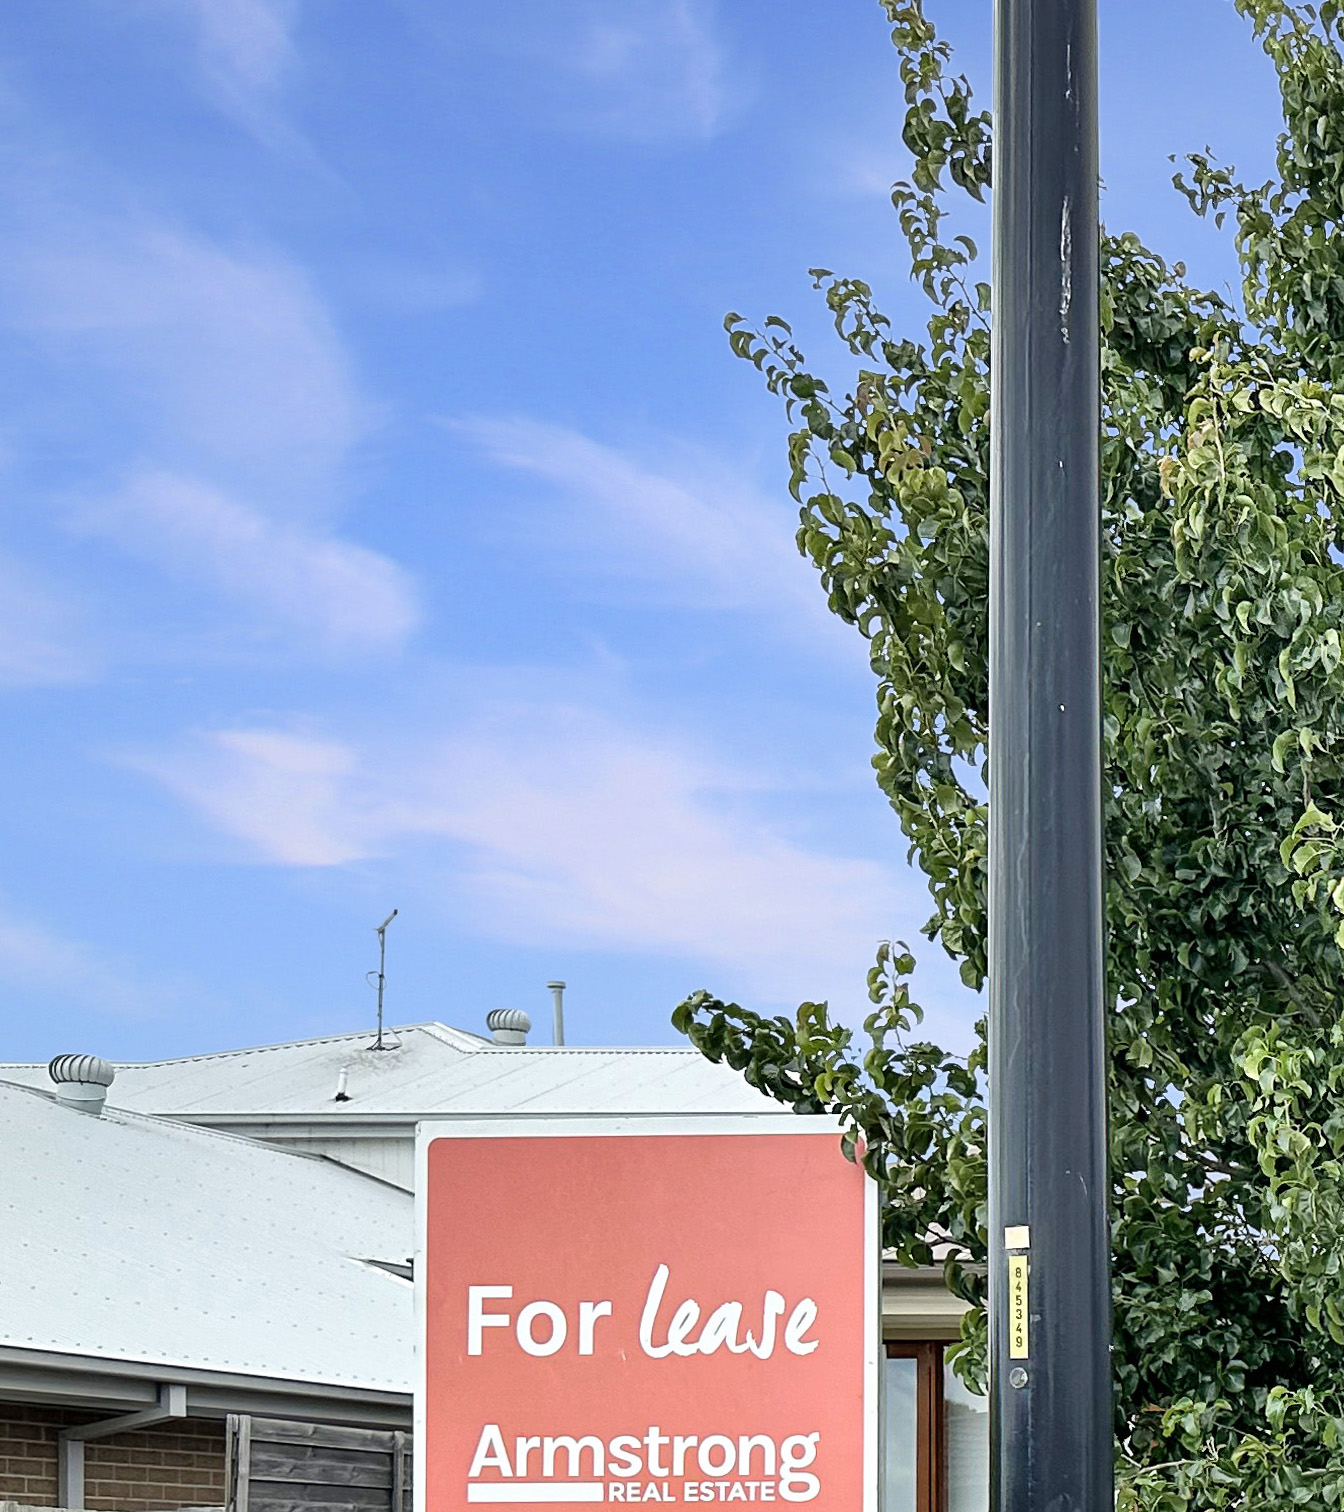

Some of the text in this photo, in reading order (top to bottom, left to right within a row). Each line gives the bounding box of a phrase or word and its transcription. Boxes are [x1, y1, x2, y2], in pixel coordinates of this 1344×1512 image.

[467, 1263, 820, 1360] For lease
[1015, 1267, 1023, 1348] 845349
[468, 1424, 821, 1502] Armstrong
[609, 1481, 776, 1502] REAL ESTATE
